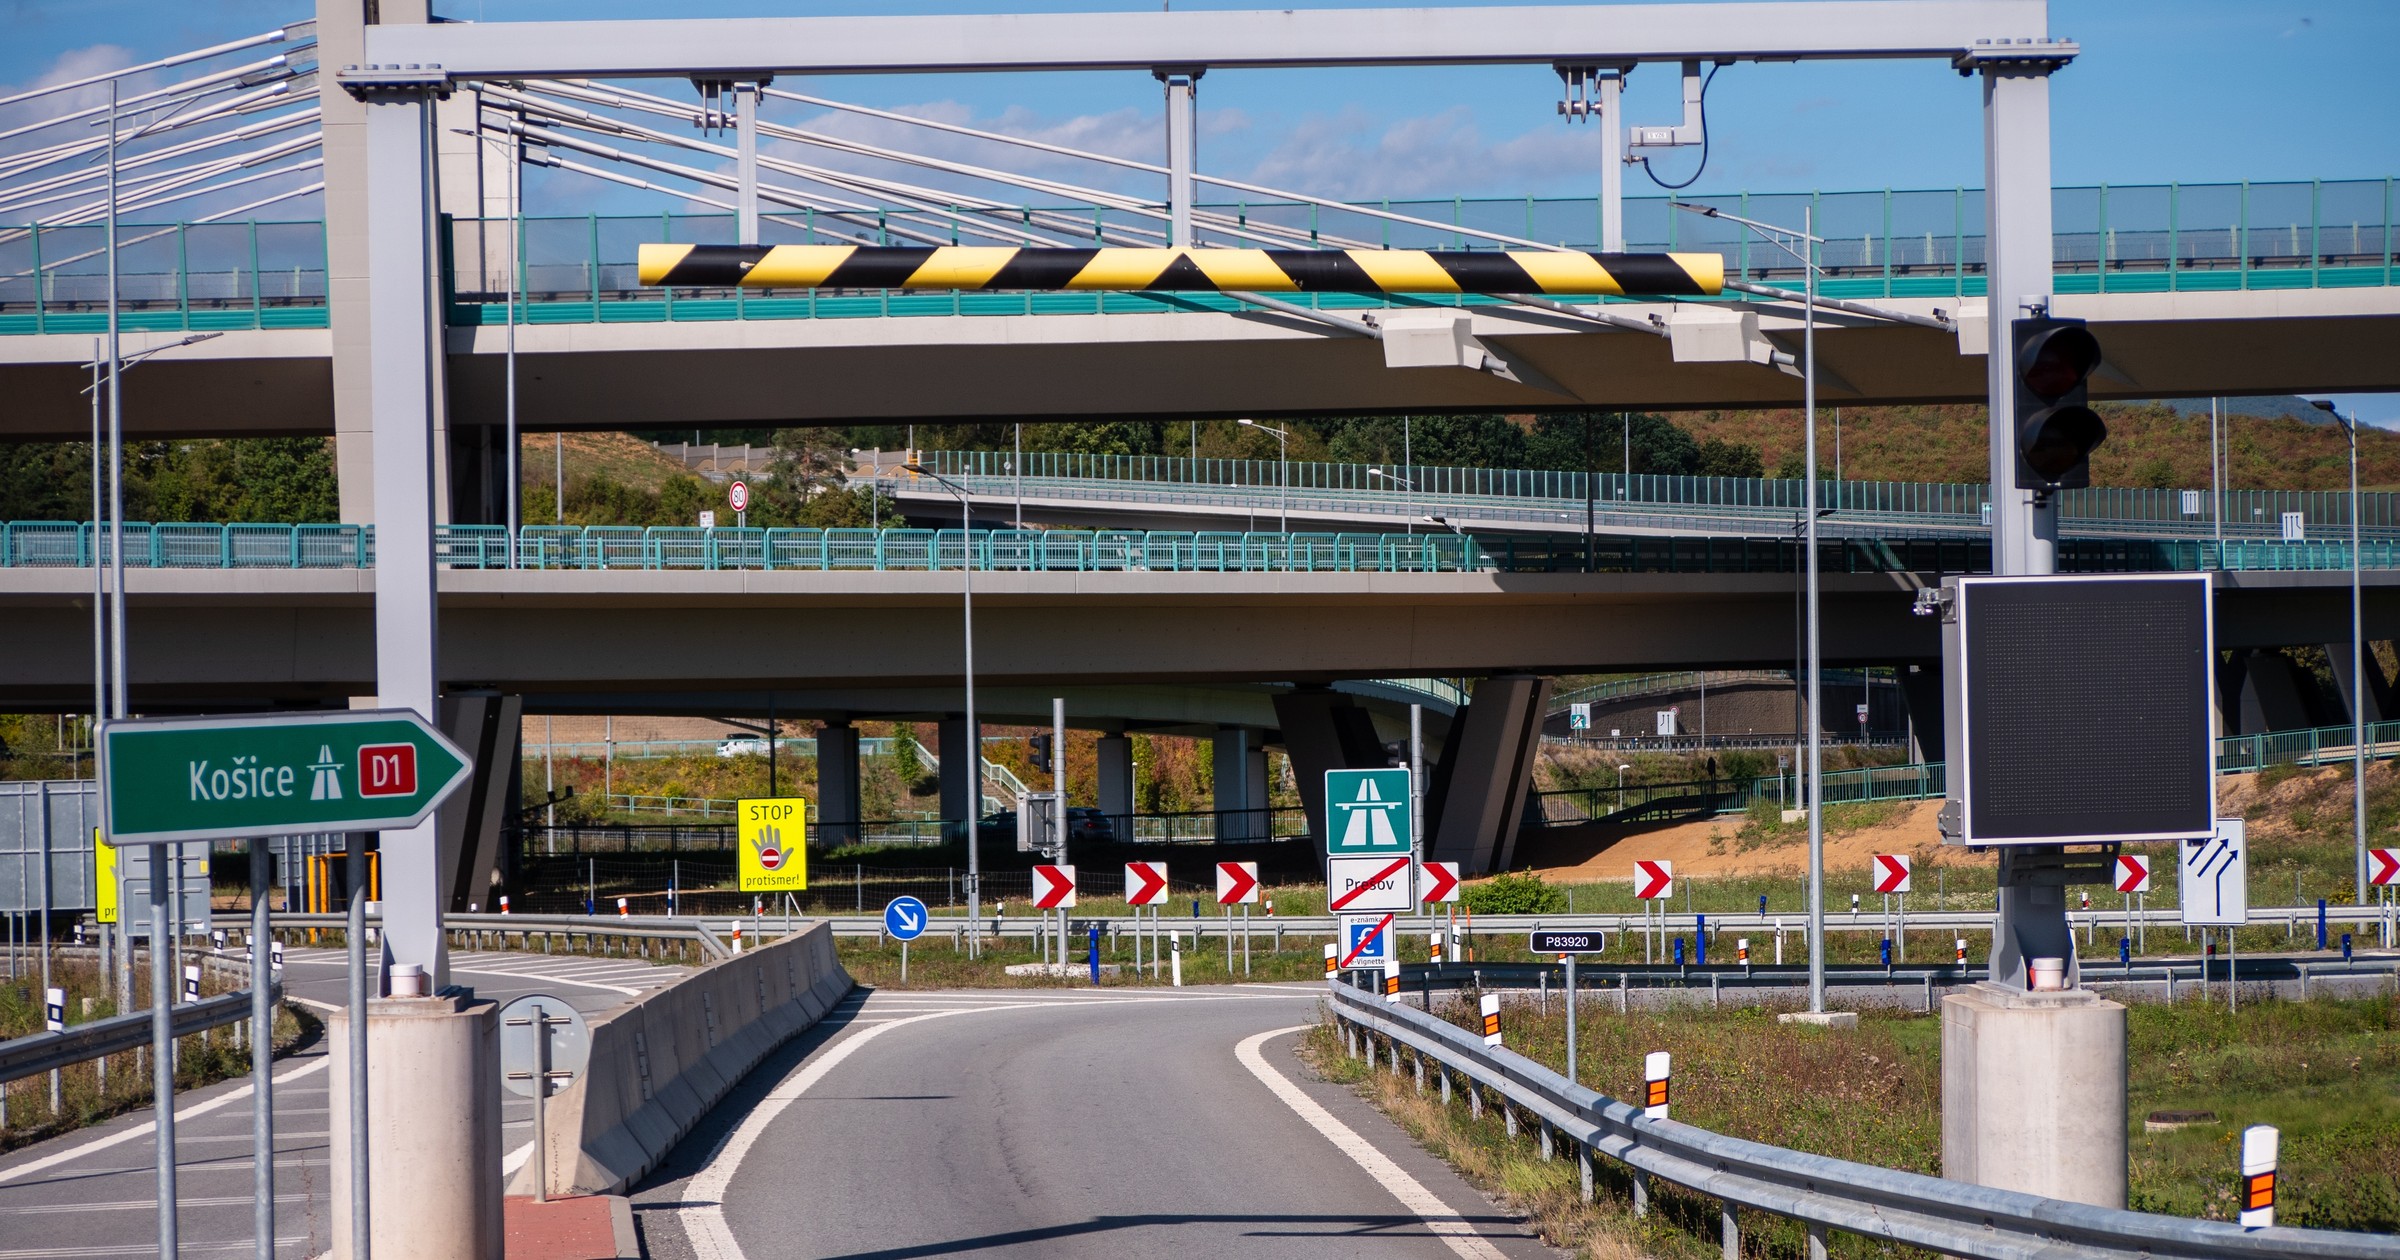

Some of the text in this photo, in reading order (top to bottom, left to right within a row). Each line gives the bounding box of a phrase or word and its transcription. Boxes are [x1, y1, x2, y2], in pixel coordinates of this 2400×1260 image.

[734, 490, 744, 503] 80
[189, 754, 400, 801] Košice D1
[750, 804, 793, 821] STOP
[746, 874, 800, 888] protismer!
[1345, 877, 1395, 891] Prešov
[1350, 916, 1383, 924] e-známka
[1545, 936, 1589, 947] P83920
